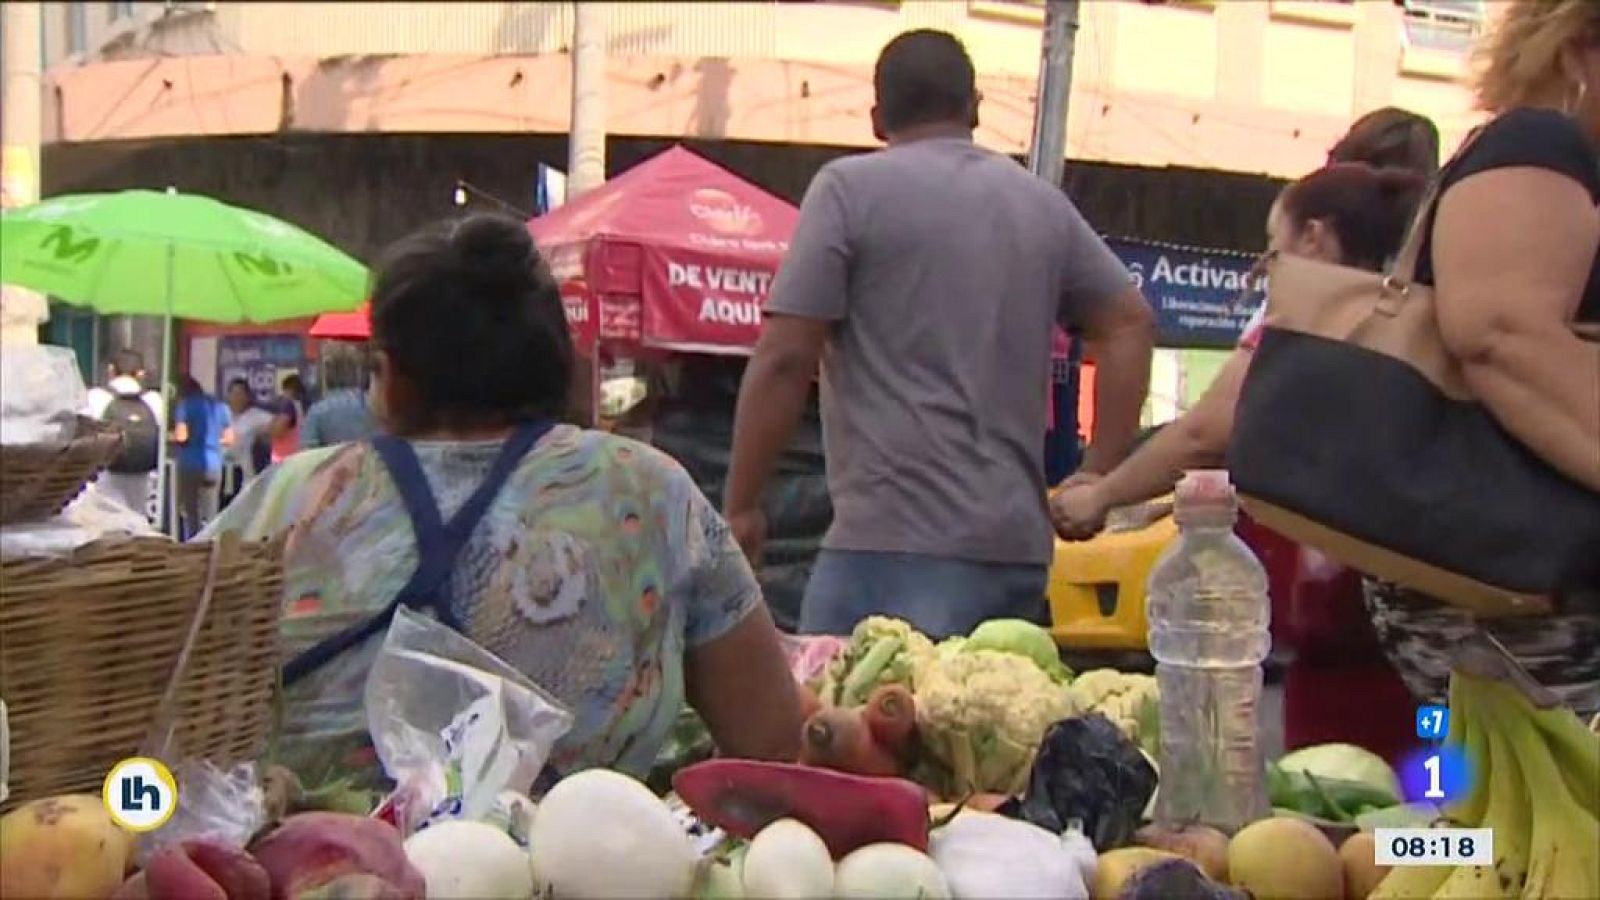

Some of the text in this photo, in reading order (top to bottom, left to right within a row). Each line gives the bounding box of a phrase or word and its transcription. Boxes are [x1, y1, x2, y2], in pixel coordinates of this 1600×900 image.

[668, 262, 773, 295] DE VENT
[699, 296, 762, 325] AQUÍ
